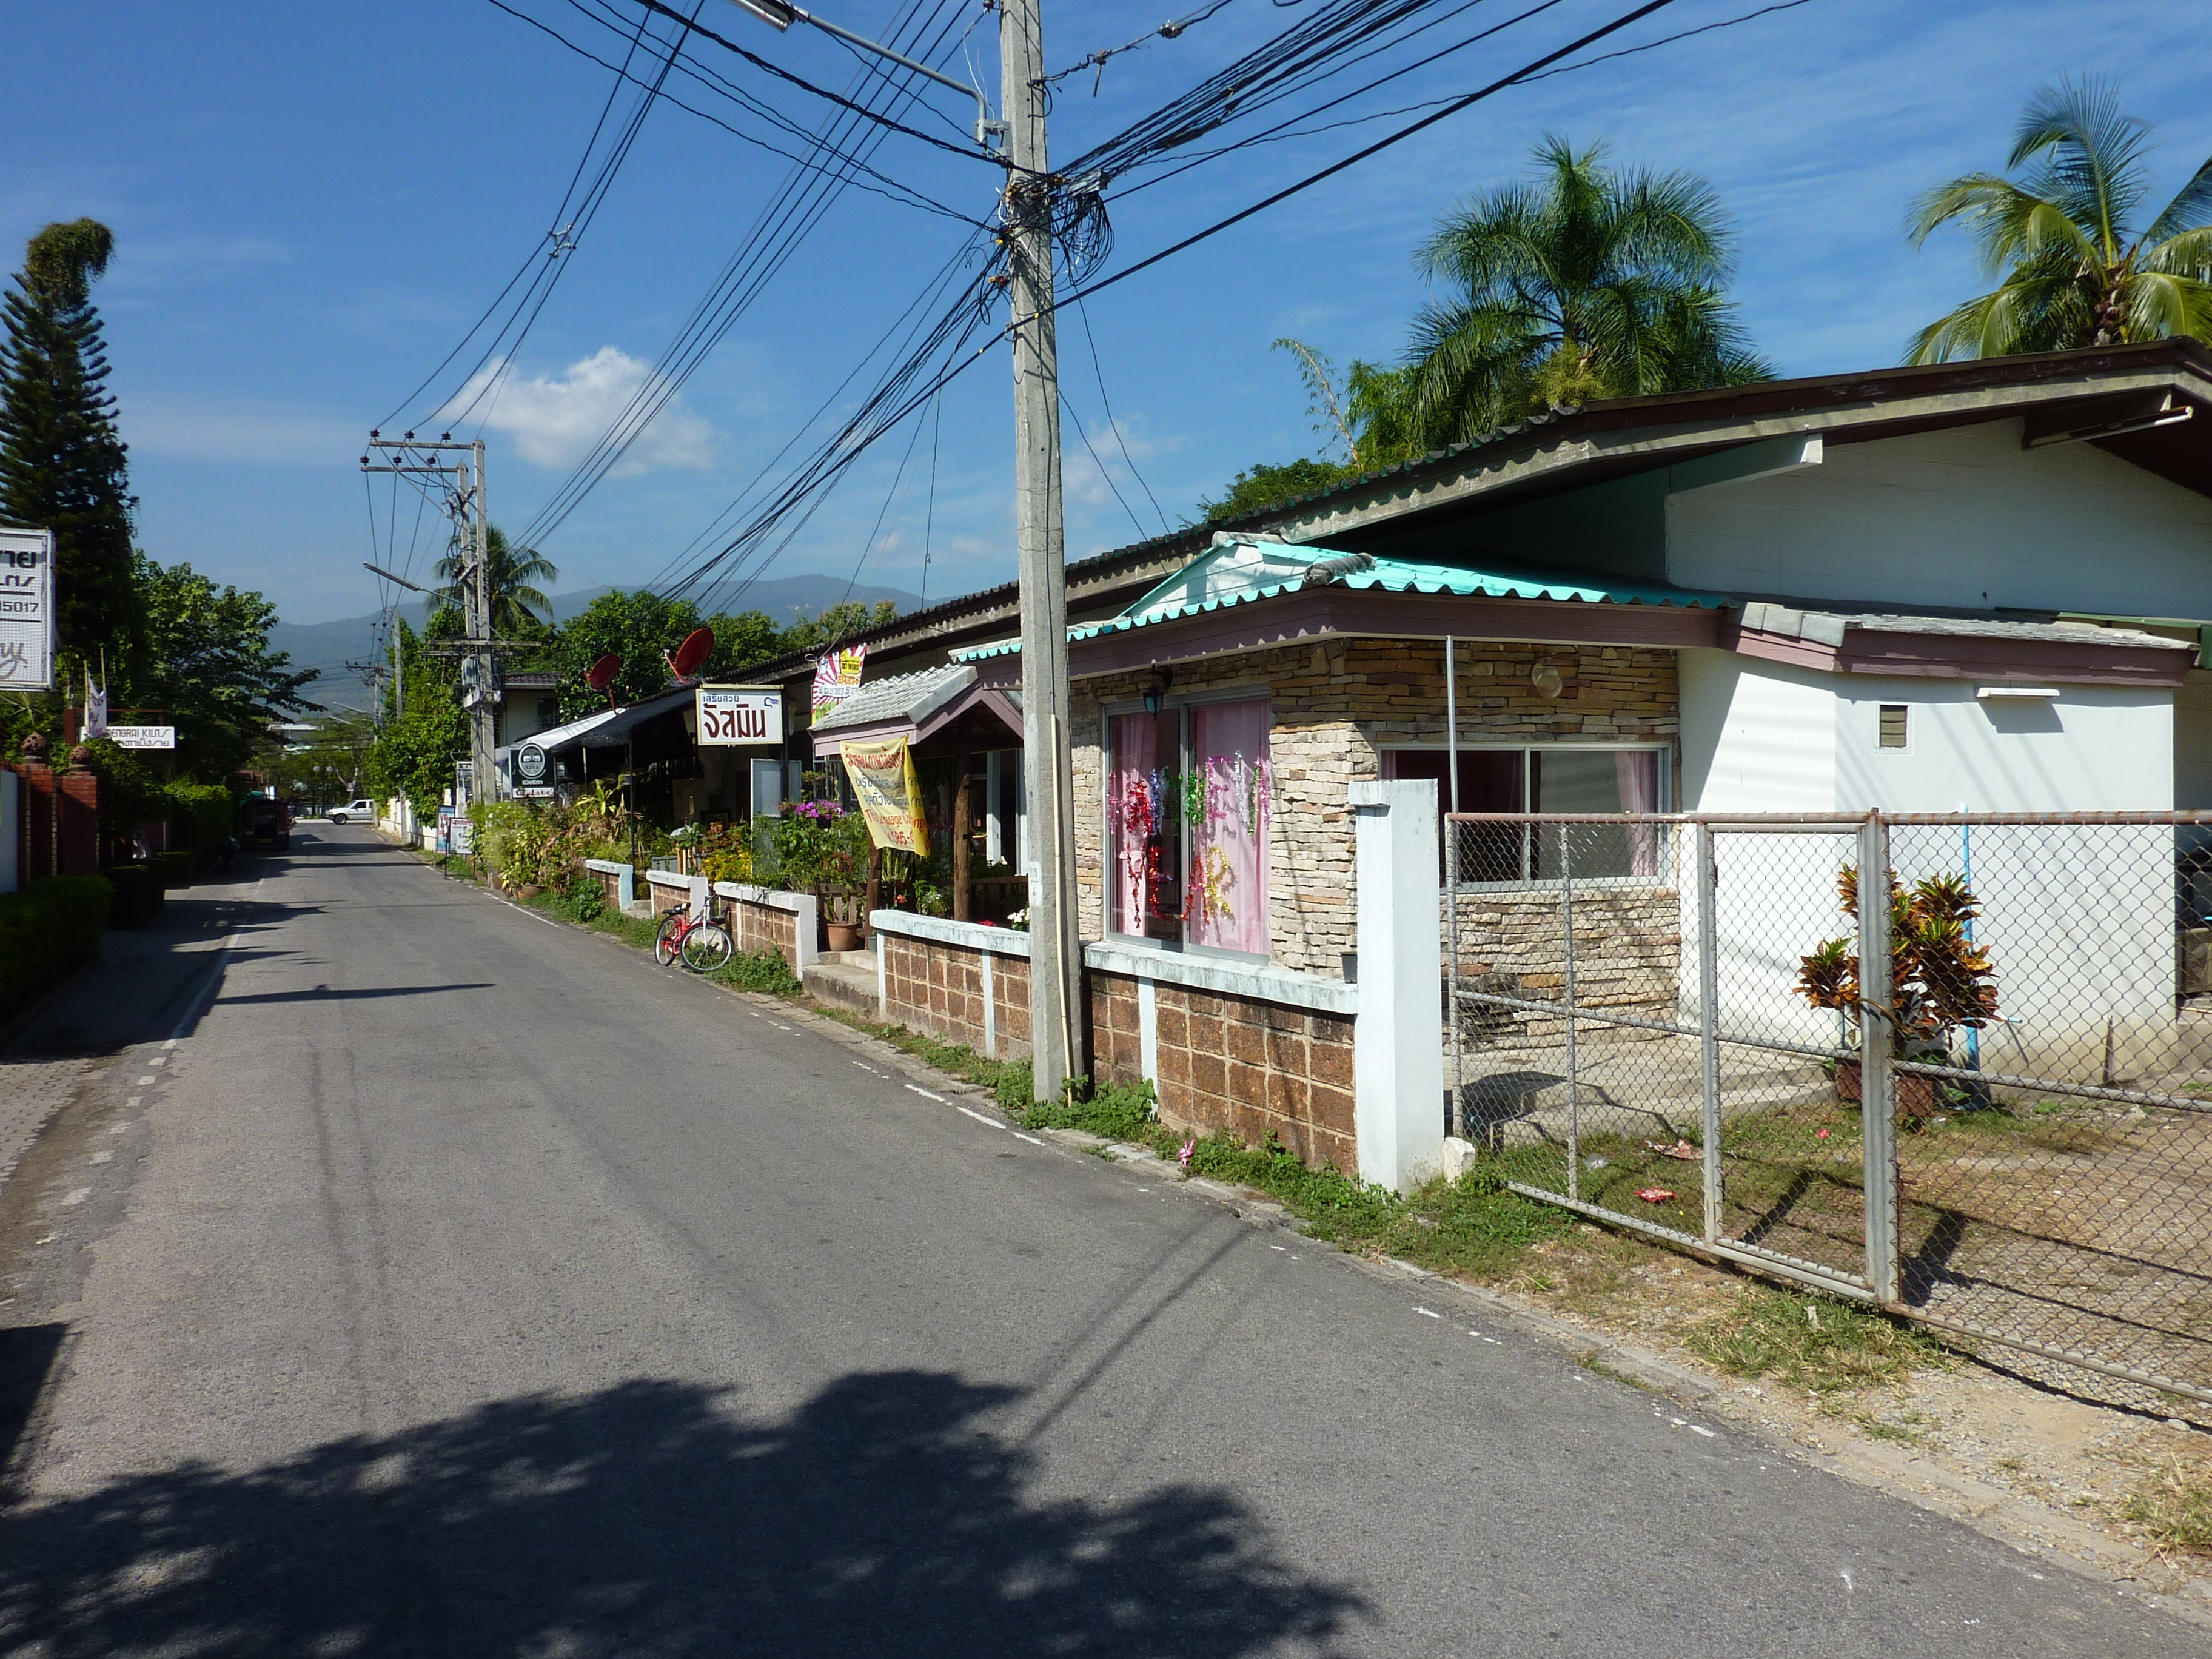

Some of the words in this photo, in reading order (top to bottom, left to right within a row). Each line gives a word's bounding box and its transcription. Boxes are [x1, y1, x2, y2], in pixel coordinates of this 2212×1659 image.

[0, 549, 36, 568] าย
[703, 694, 739, 702] เสริมสวย
[703, 703, 766, 738] จัสมิน
